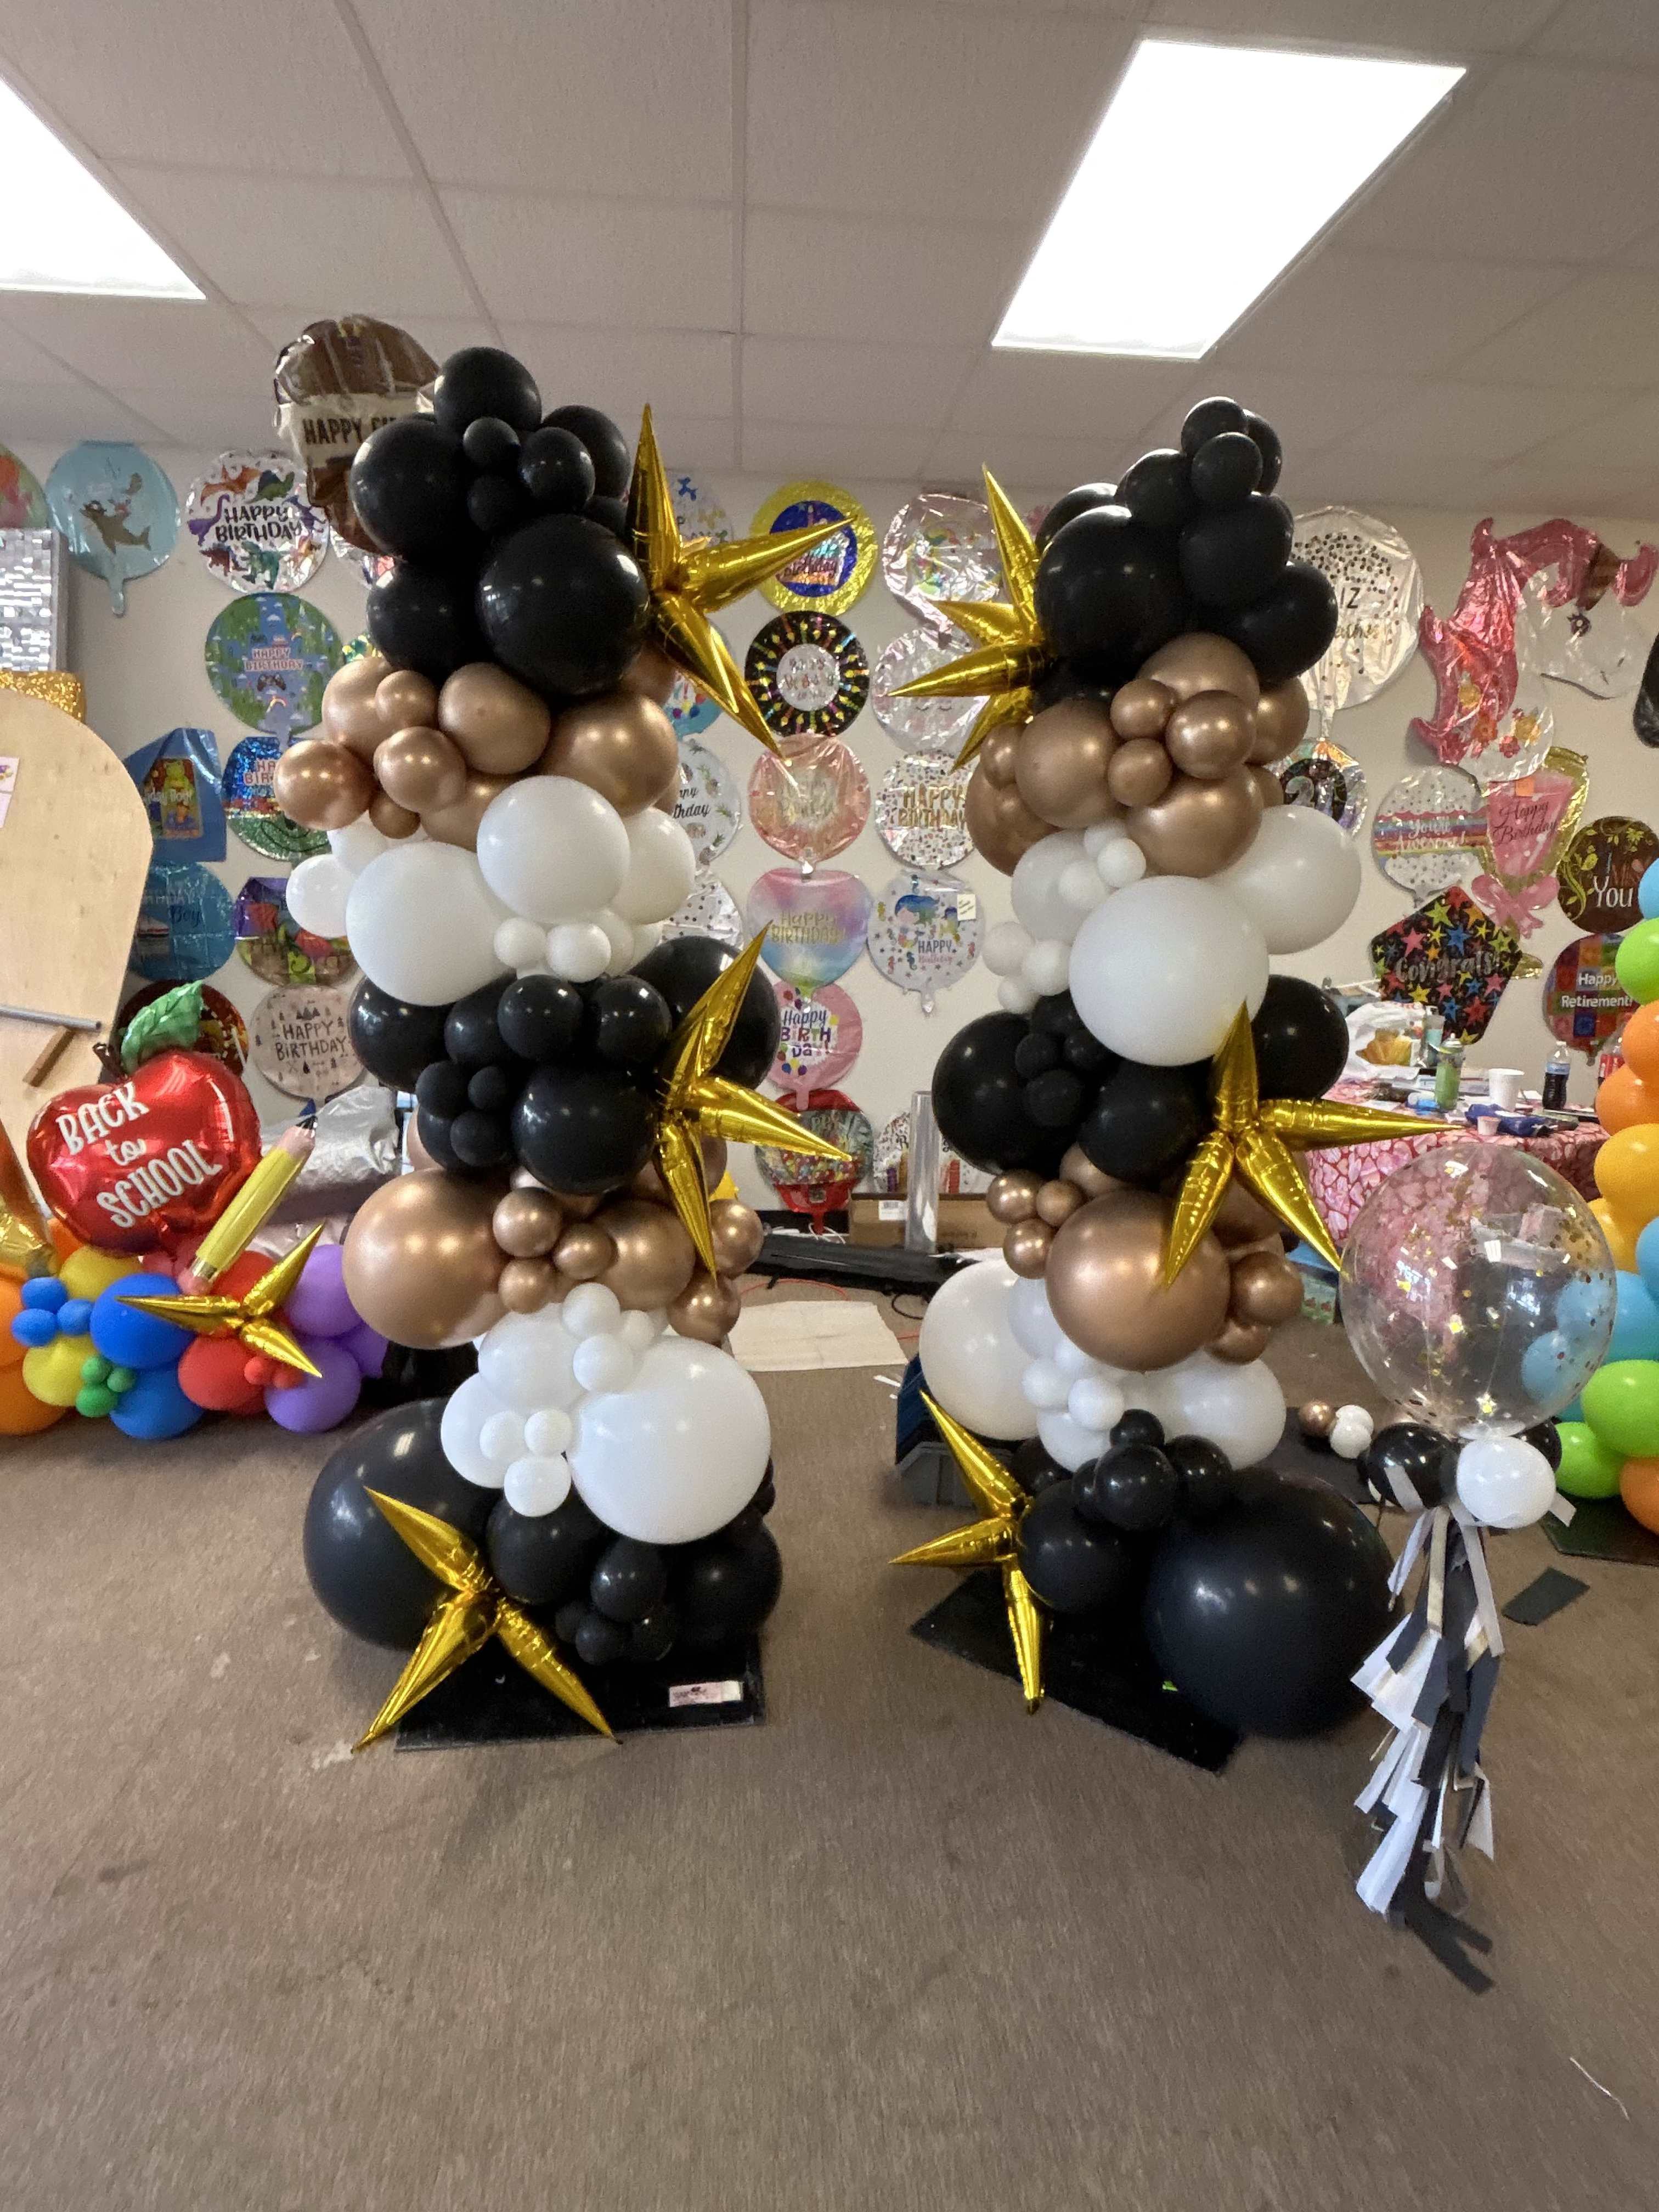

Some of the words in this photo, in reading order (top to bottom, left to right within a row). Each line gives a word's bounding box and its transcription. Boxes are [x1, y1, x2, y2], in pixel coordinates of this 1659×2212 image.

[303, 417, 363, 445] HAPPY
[224, 506, 289, 523] HAPPY
[215, 521, 302, 543] BIRTHDAY
[253, 648, 290, 658] HAPPY
[903, 783, 966, 809] HAPPY
[898, 808, 967, 833] BIRTHDAY
[1593, 876, 1633, 908] You
[918, 939, 952, 953] HAPPY
[1395, 951, 1500, 984] Congrats!
[1578, 972, 1617, 986] Happy
[283, 1020, 334, 1040] HAPPY
[783, 1009, 827, 1029] Happy
[55, 1081, 150, 1156] BACK
[105, 1138, 146, 1166] to
[97, 1139, 224, 1228] SCHOOL
